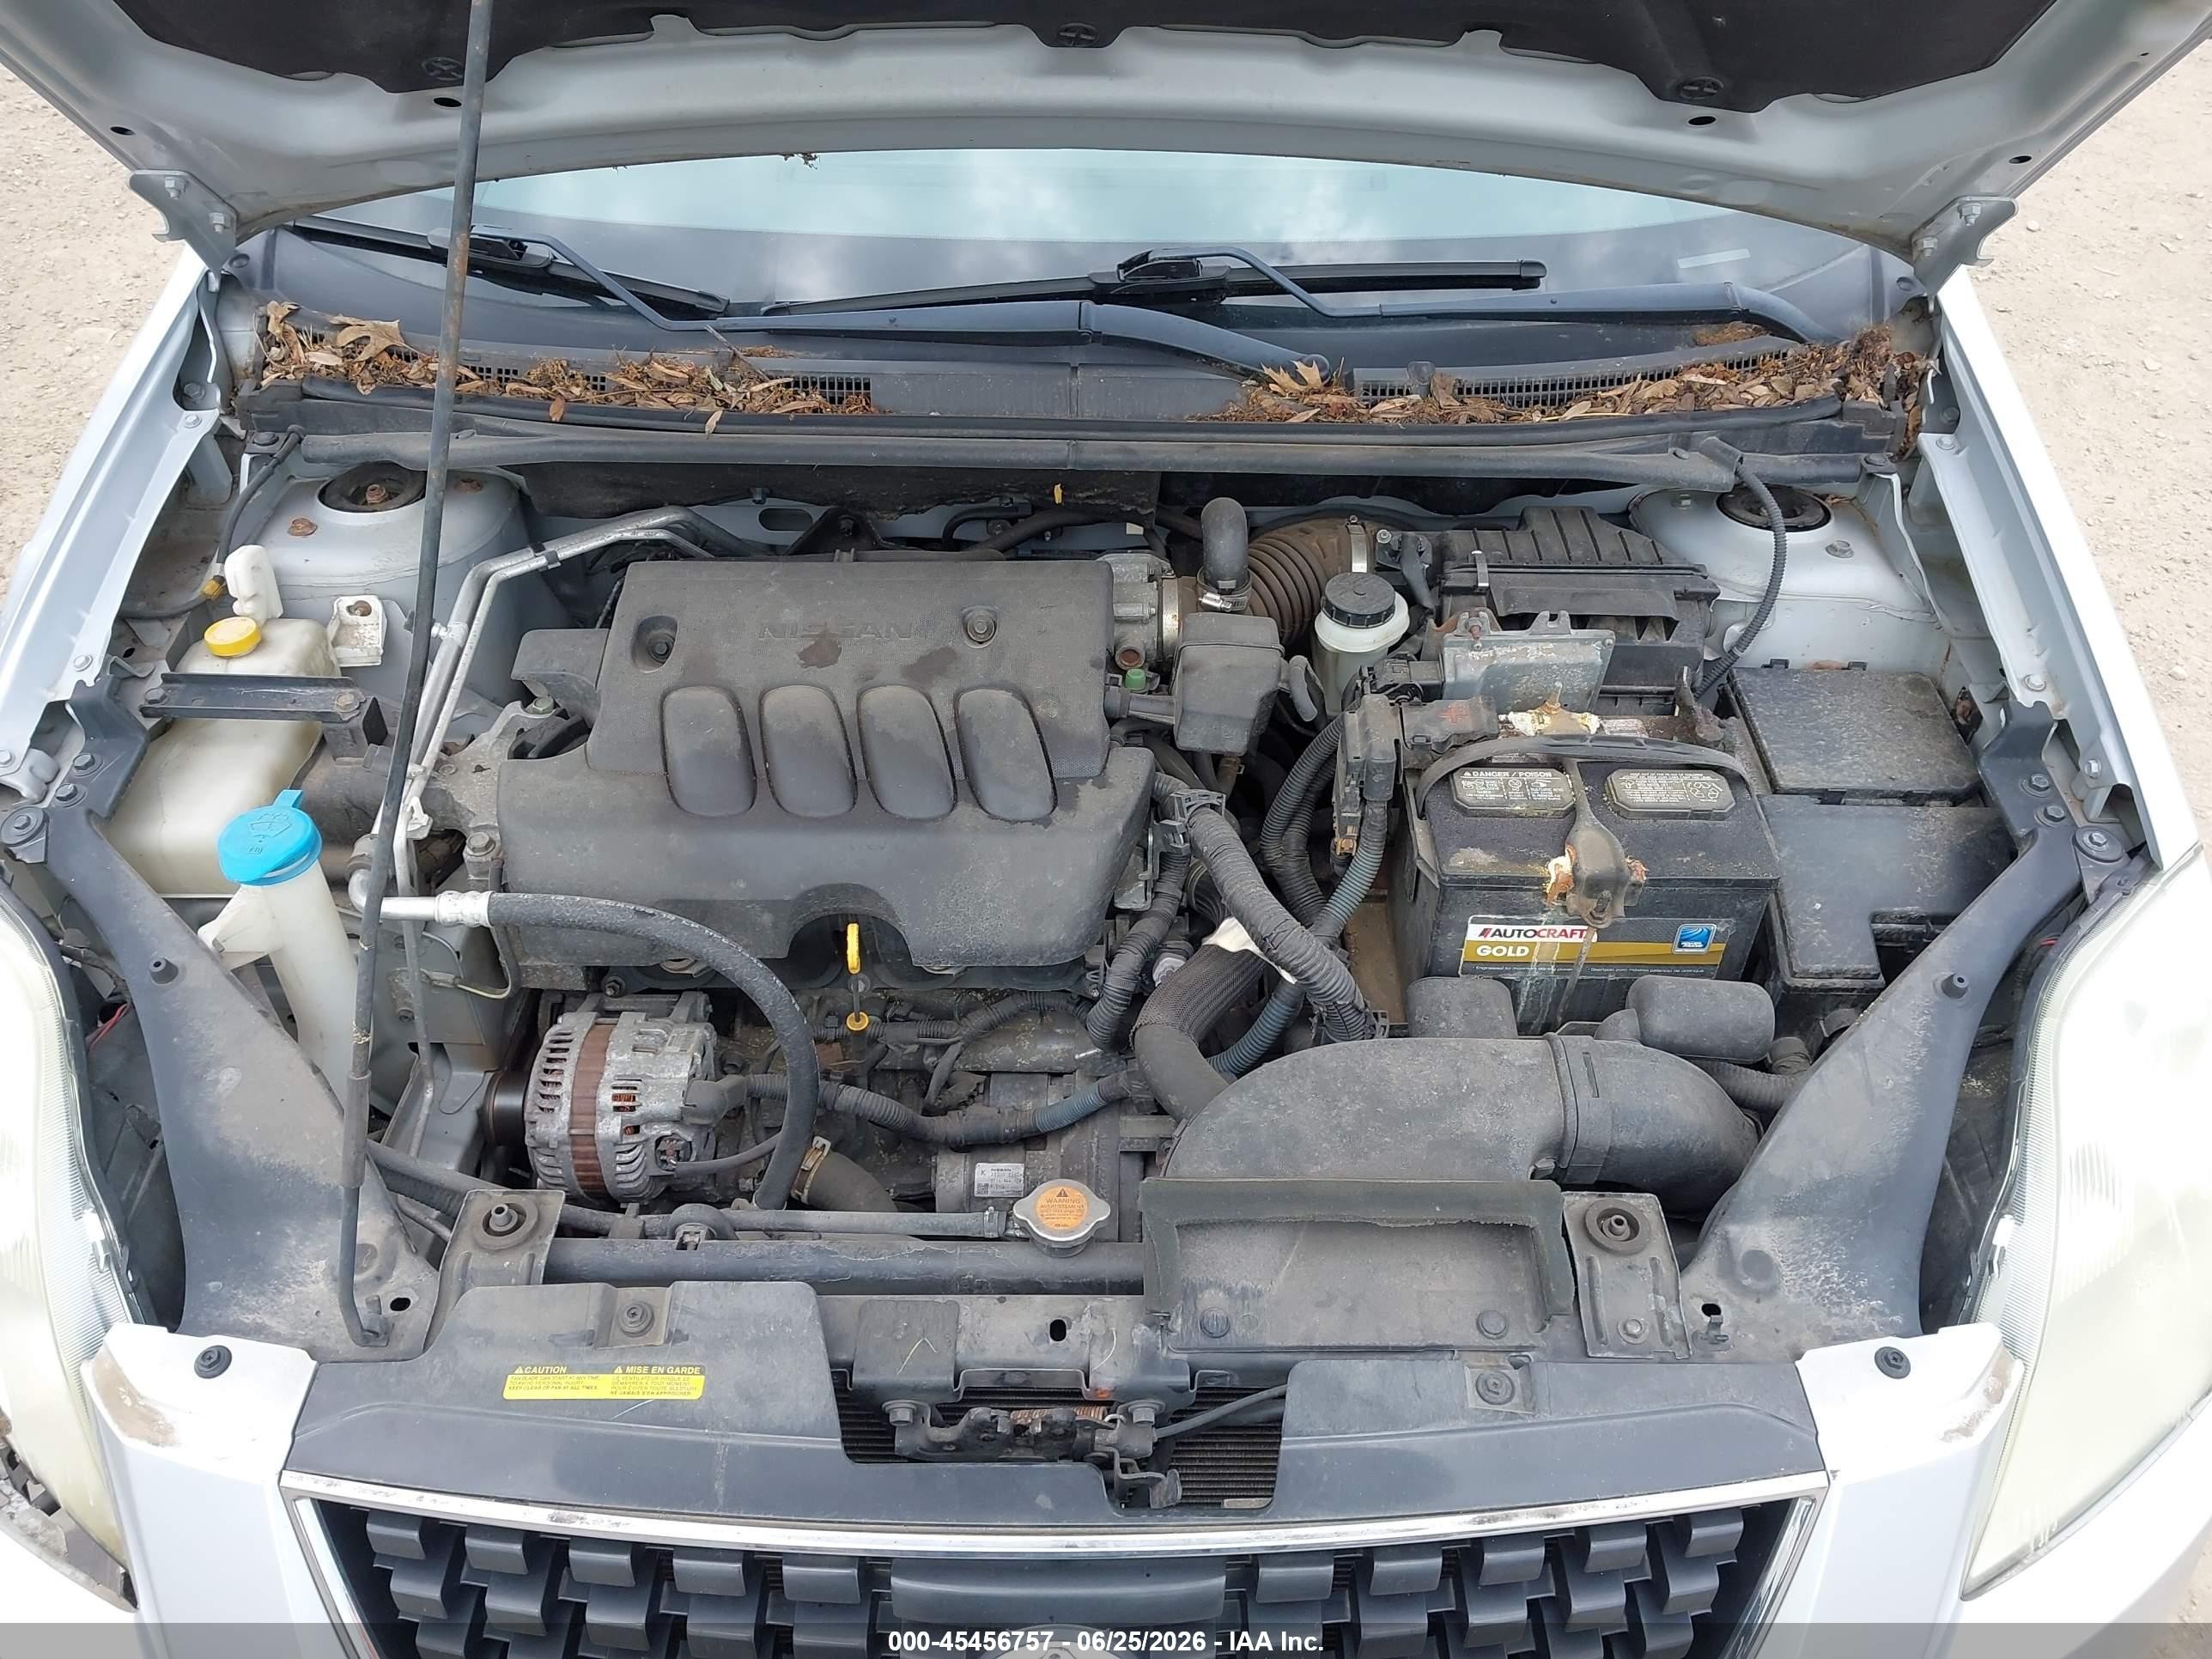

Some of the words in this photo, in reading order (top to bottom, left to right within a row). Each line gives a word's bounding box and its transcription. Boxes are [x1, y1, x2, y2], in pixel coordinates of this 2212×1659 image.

[759, 623, 913, 640] NISSAN
[1491, 928, 1587, 939] AUTOCRAFT
[1476, 945, 1530, 957] GOLD
[625, 1365, 649, 1374] MISE
[651, 1365, 665, 1374] EN
[666, 1365, 702, 1374] GARDE
